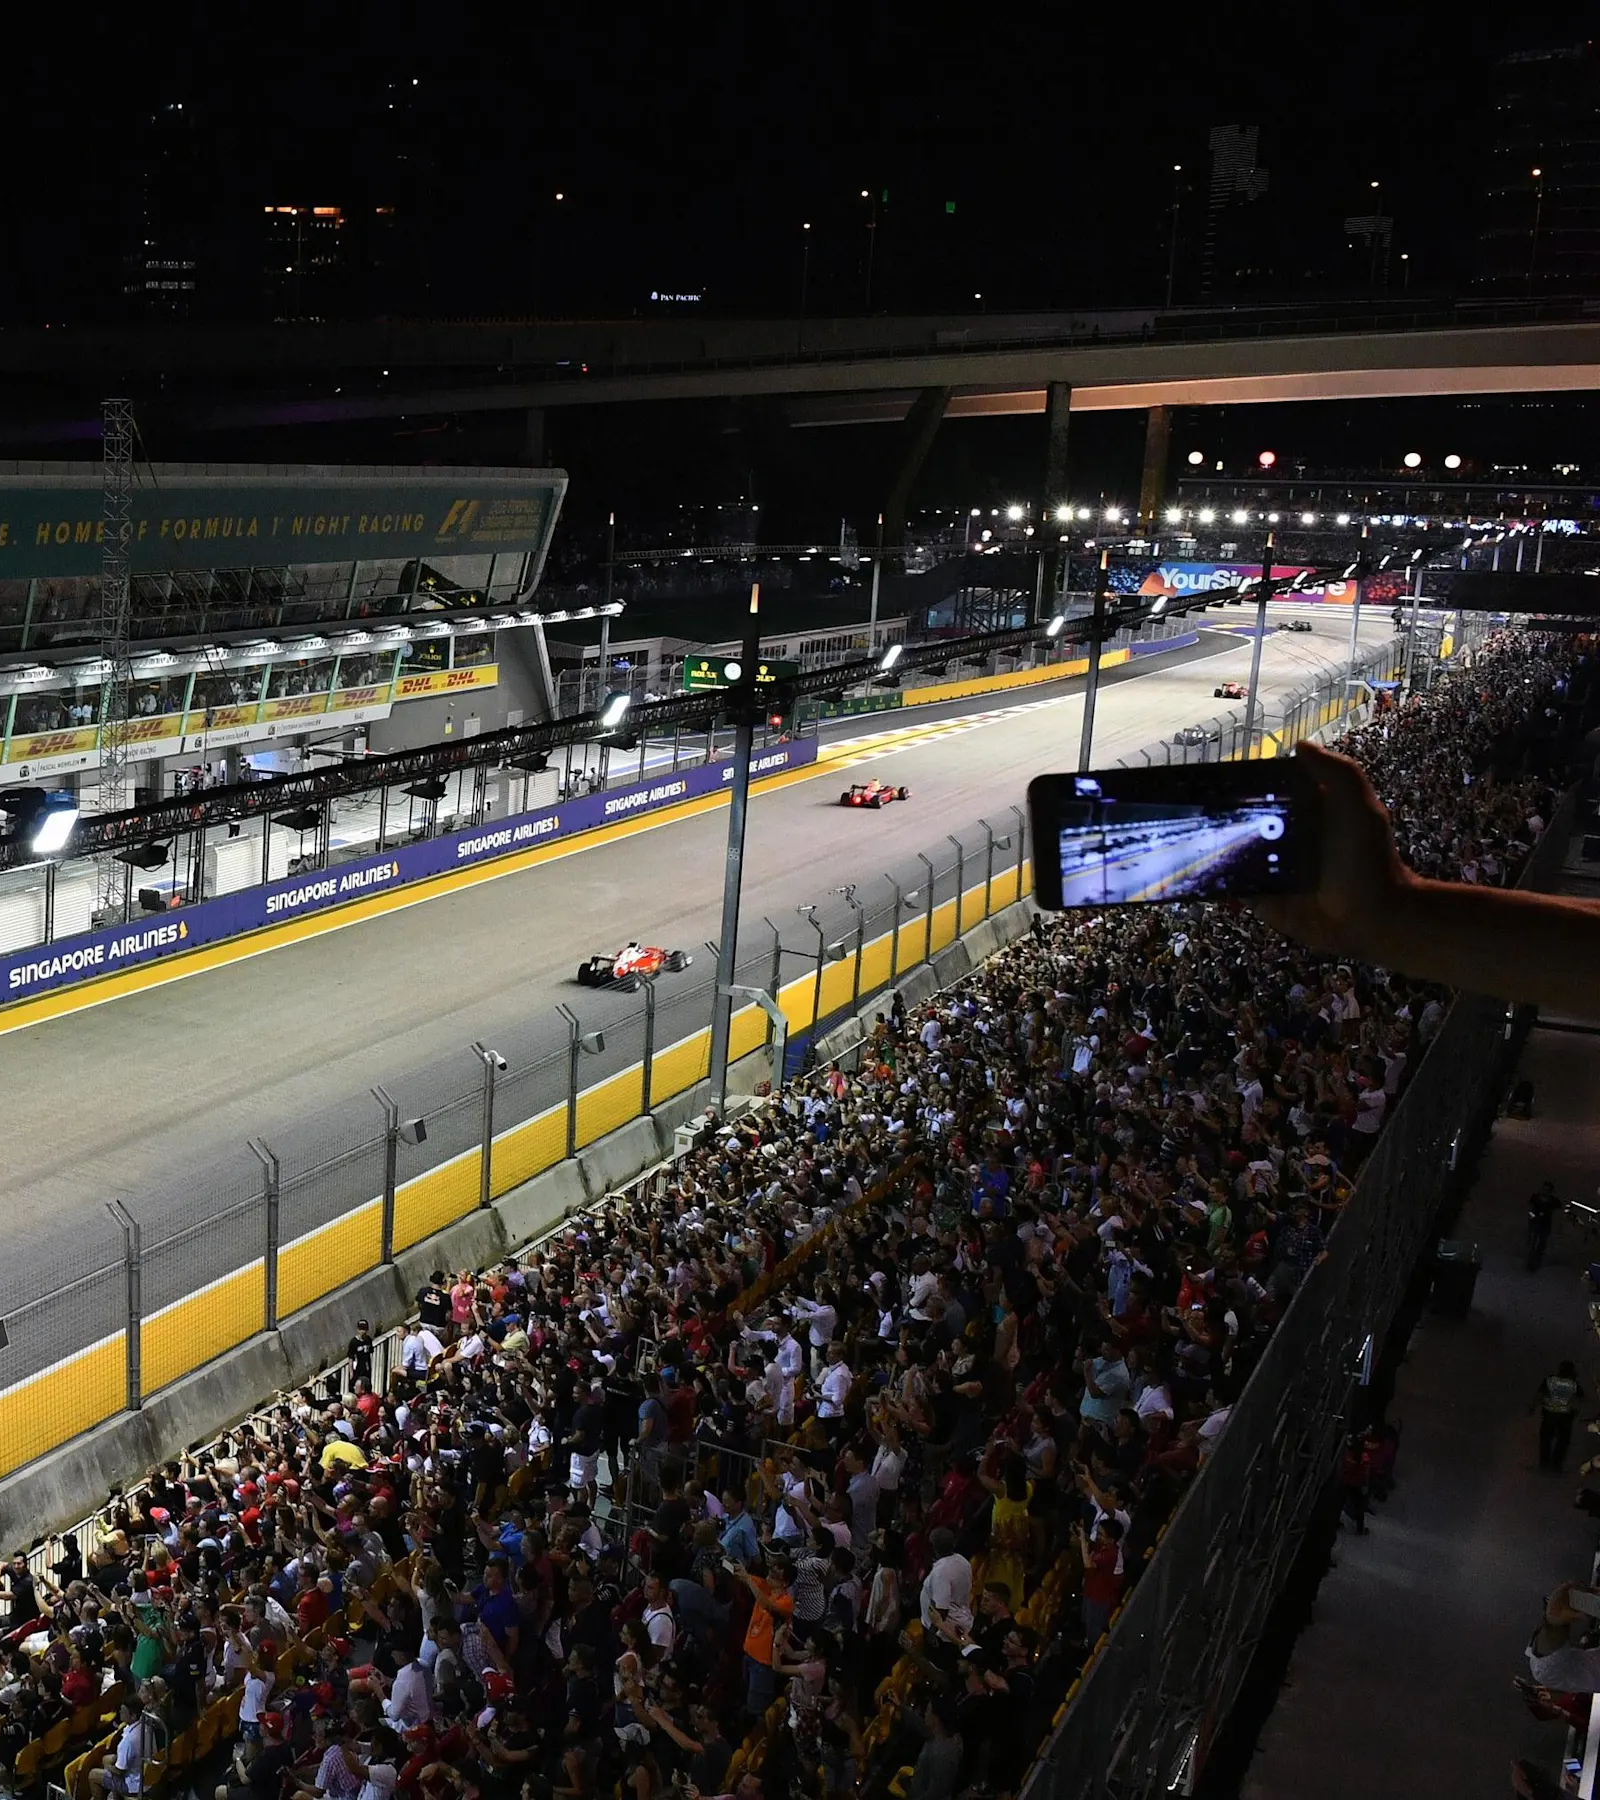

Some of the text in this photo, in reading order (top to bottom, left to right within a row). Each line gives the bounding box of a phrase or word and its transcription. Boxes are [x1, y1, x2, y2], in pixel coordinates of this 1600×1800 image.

[36, 520, 104, 546] HOME
[160, 516, 258, 540] FORMULA
[292, 515, 350, 537] NIGHT
[358, 513, 425, 535] RACING
[402, 677, 433, 693] DHL
[447, 671, 475, 688] DHL
[275, 699, 313, 717] DHL
[342, 687, 378, 706] DHL
[27, 732, 78, 757] DHL
[758, 752, 785, 771] AIRLINES
[605, 782, 682, 815] SINGAPORE AIRLINES
[457, 818, 554, 858] SINGAPORE AIRLINES
[266, 863, 392, 914] SINGAPORE AIRLINES
[9, 943, 104, 989] SINGAPORE
[109, 923, 178, 959] AIRLINES
